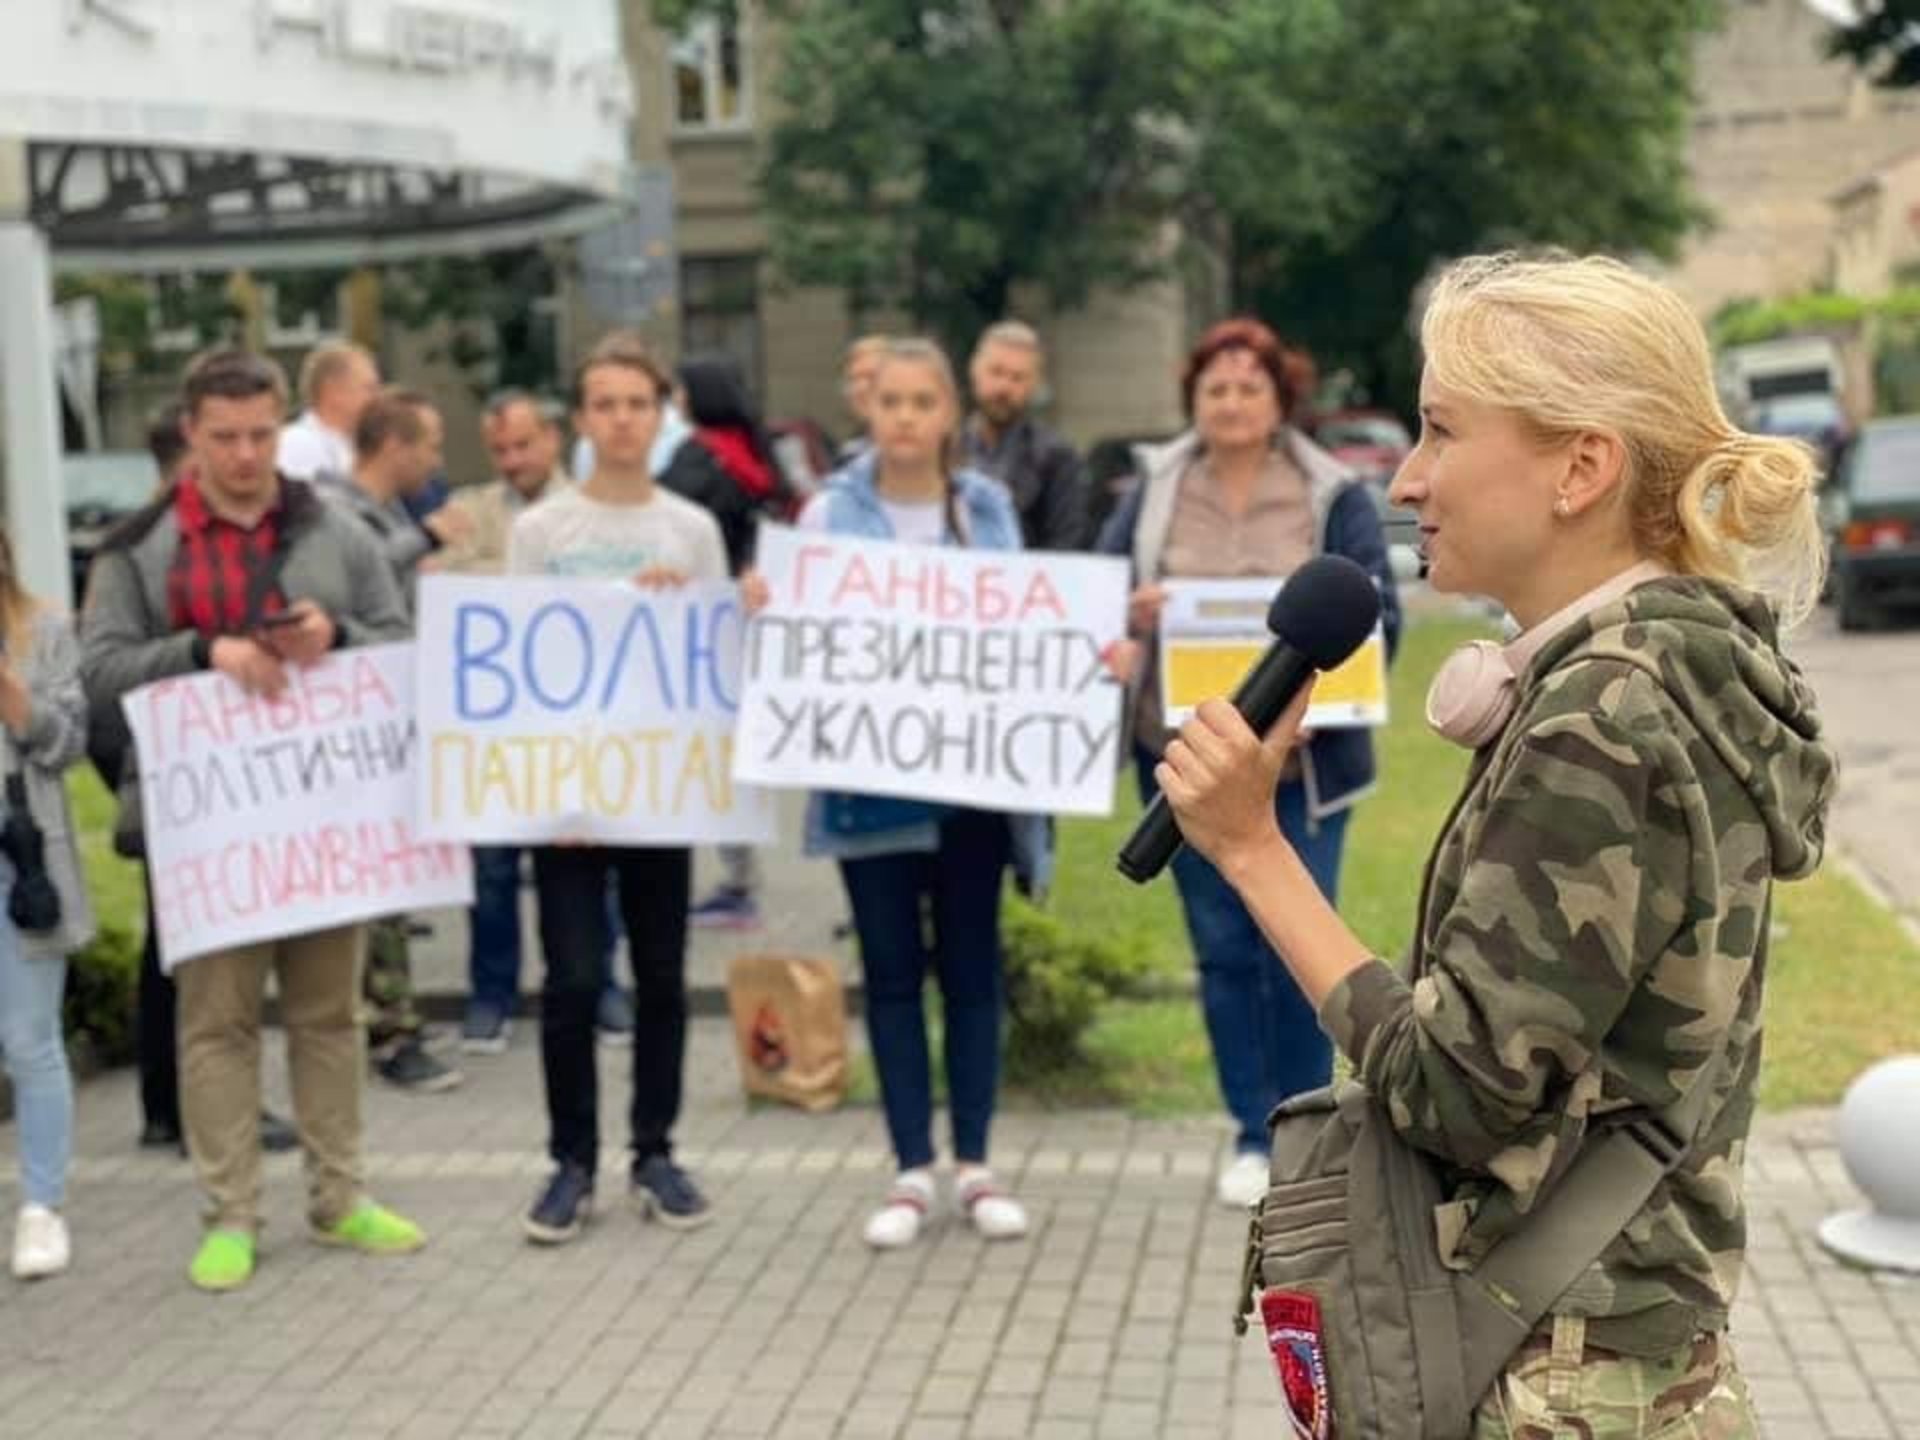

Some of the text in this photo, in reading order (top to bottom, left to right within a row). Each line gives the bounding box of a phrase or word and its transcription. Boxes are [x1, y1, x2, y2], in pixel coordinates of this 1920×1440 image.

[793, 543, 1066, 622] ГАНЬБА
[455, 601, 738, 721] ВОЛЮ
[748, 614, 1106, 694] ПРЕЗИДЕНТУ
[765, 696, 1120, 789] УКЛОНІСТУ
